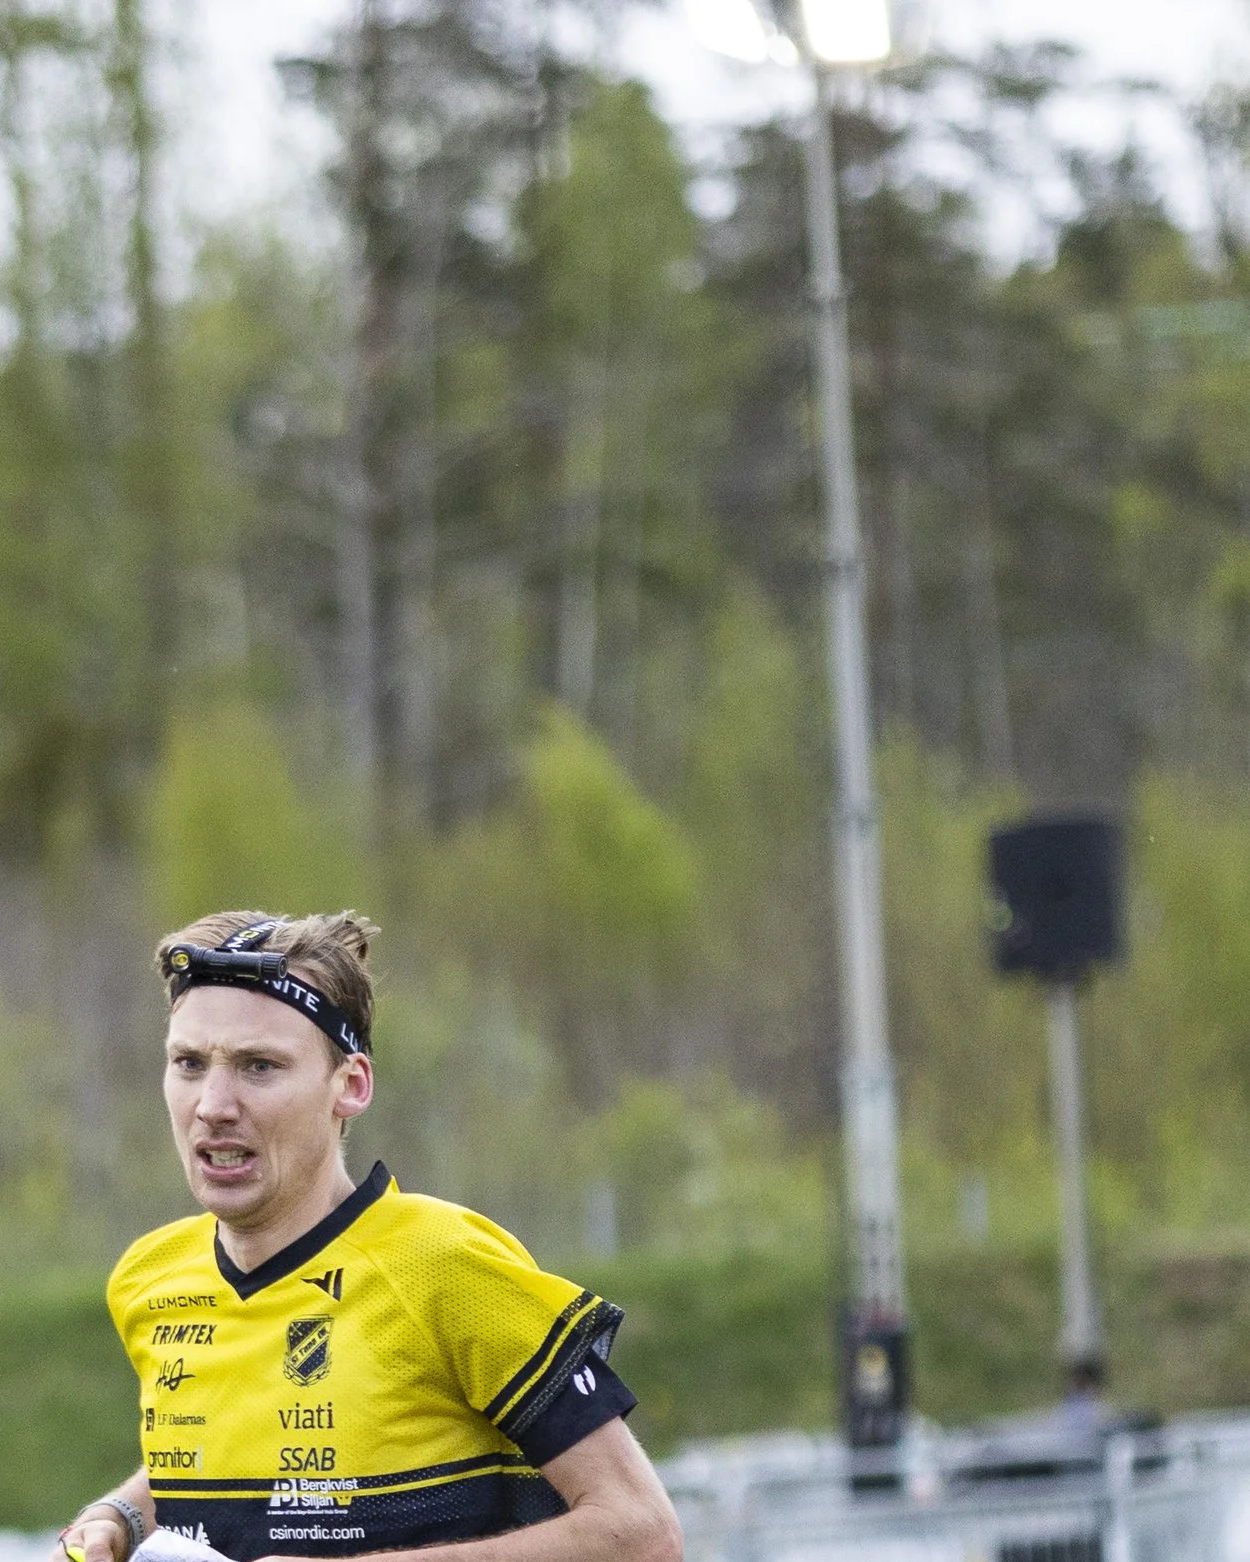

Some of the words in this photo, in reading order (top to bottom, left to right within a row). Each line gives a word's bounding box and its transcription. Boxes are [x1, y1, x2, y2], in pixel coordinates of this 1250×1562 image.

[149, 1296, 217, 1310] LUMONITE
[152, 1324, 217, 1345] TRIMTEX
[278, 1401, 335, 1430] viati
[149, 1446, 197, 1473] granitor
[279, 1447, 336, 1471] SSAB
[300, 1478, 359, 1494] Bergkvist
[301, 1494, 335, 1509] Siljan
[270, 1525, 365, 1540] csinordic.com
